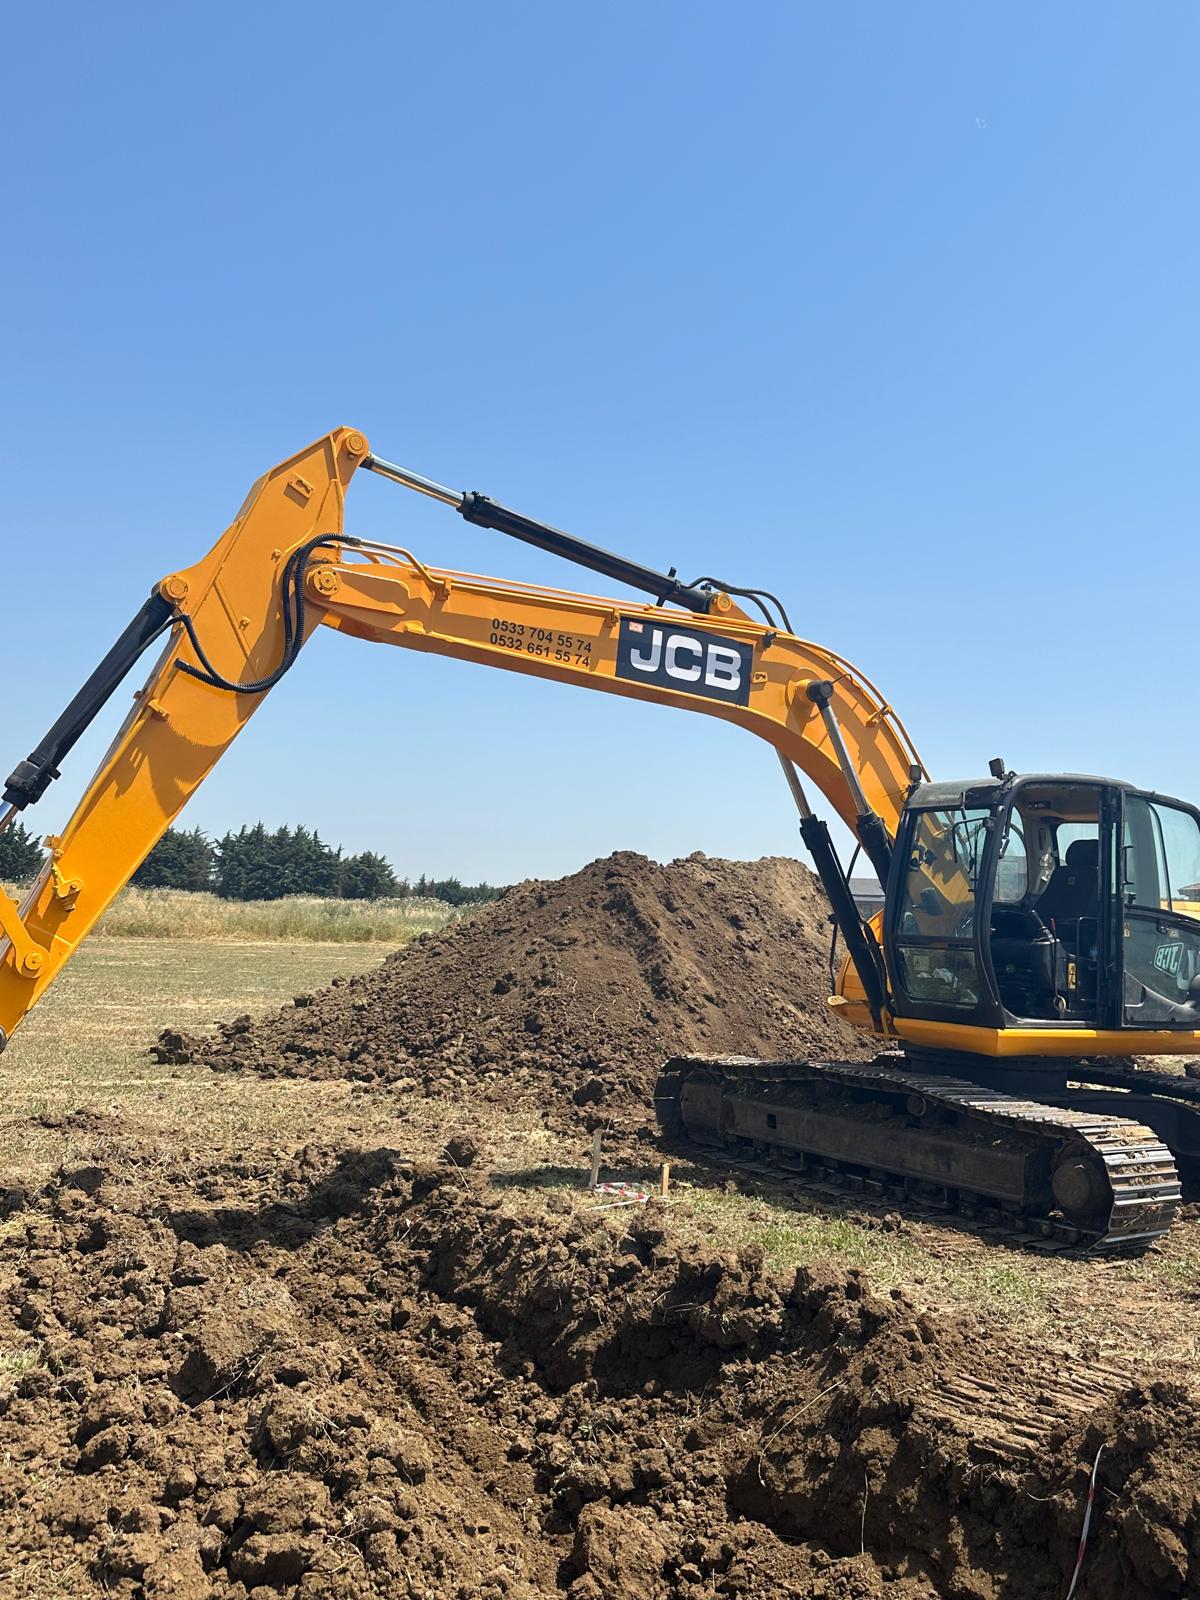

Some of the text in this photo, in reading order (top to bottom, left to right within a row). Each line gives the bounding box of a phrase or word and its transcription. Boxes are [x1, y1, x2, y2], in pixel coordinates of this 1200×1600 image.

[490, 633, 590, 668] 0532 651 55 74
[492, 618, 592, 653] 0533 704 55 74
[630, 629, 741, 691] JCB
